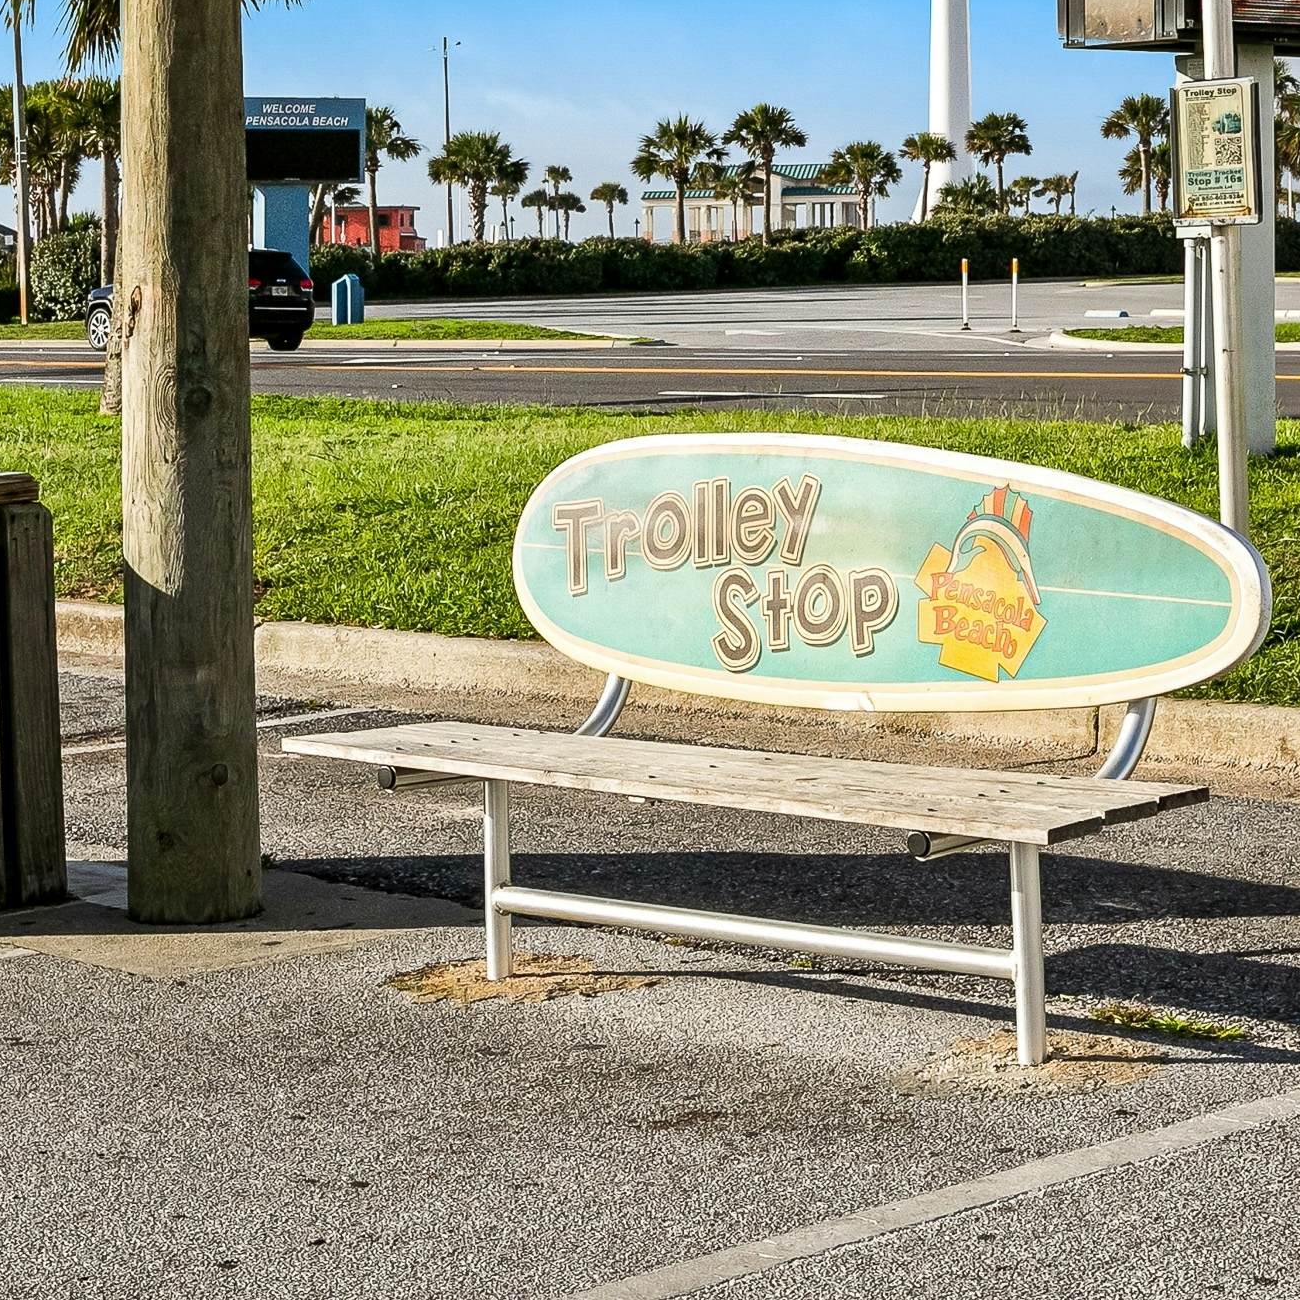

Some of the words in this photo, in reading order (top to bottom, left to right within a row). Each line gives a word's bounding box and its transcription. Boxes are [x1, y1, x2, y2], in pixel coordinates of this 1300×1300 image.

[1183, 89, 1215, 97] Trolley
[1217, 87, 1237, 95] Stop
[245, 116, 309, 126] PENSACOLA
[312, 116, 349, 126] BEACH
[262, 104, 317, 113] WELCOME
[1188, 177, 1211, 187] Stop
[1214, 176, 1221, 184] #
[553, 474, 822, 596] Trolley
[930, 571, 1034, 632] Pensacola
[711, 564, 900, 674] Stop
[932, 605, 1018, 659] Beach
